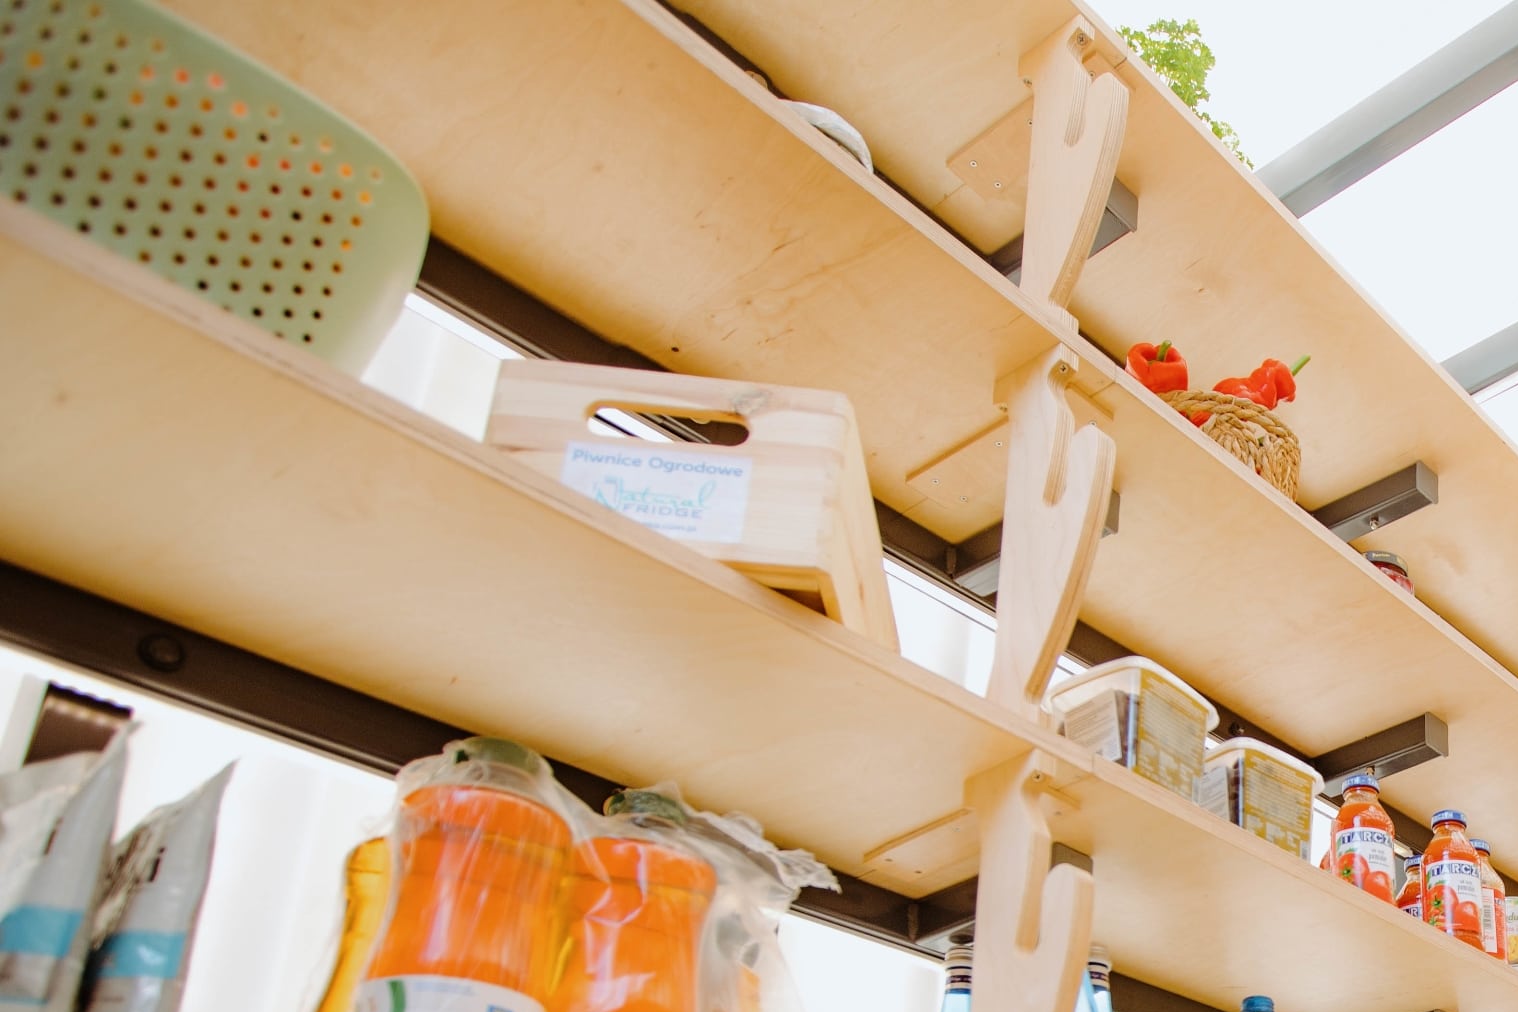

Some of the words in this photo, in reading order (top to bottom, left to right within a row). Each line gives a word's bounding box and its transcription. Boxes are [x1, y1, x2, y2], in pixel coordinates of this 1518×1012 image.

[572, 448, 643, 468] Piwnice
[649, 456, 745, 477] Ogrodowe
[622, 502, 704, 520] FRIDGE
